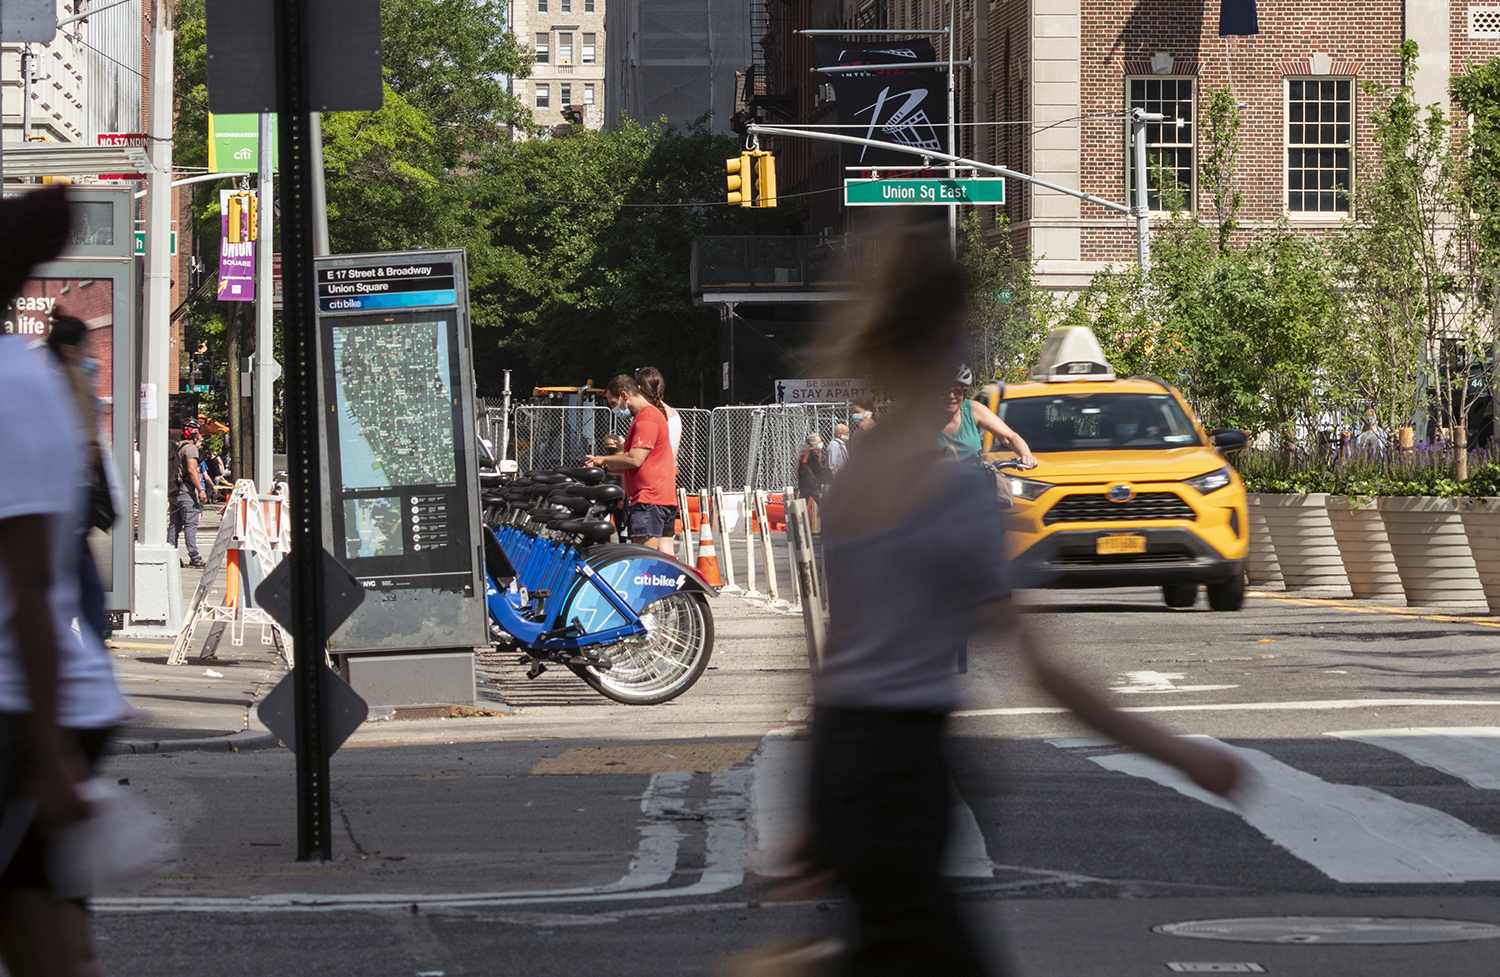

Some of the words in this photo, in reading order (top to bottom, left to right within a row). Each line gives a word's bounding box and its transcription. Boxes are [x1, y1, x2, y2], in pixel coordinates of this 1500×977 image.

[100, 138, 112, 147] NO
[114, 137, 148, 147] STANDIN
[233, 148, 252, 160] citi
[883, 185, 915, 198] Union
[920, 185, 935, 201] Sq
[940, 185, 967, 198] East
[223, 259, 251, 267] SQUARE
[327, 271, 334, 279] E
[336, 270, 347, 279] 17
[348, 268, 376, 278] Street
[377, 268, 385, 277] &
[386, 266, 431, 276] Broadway
[328, 284, 354, 293] Union
[356, 282, 388, 293] Square
[16, 296, 55, 314] easy
[18, 316, 44, 334] life
[806, 380, 818, 388] BE
[792, 389, 822, 399] STAY
[826, 388, 867, 398] APART
